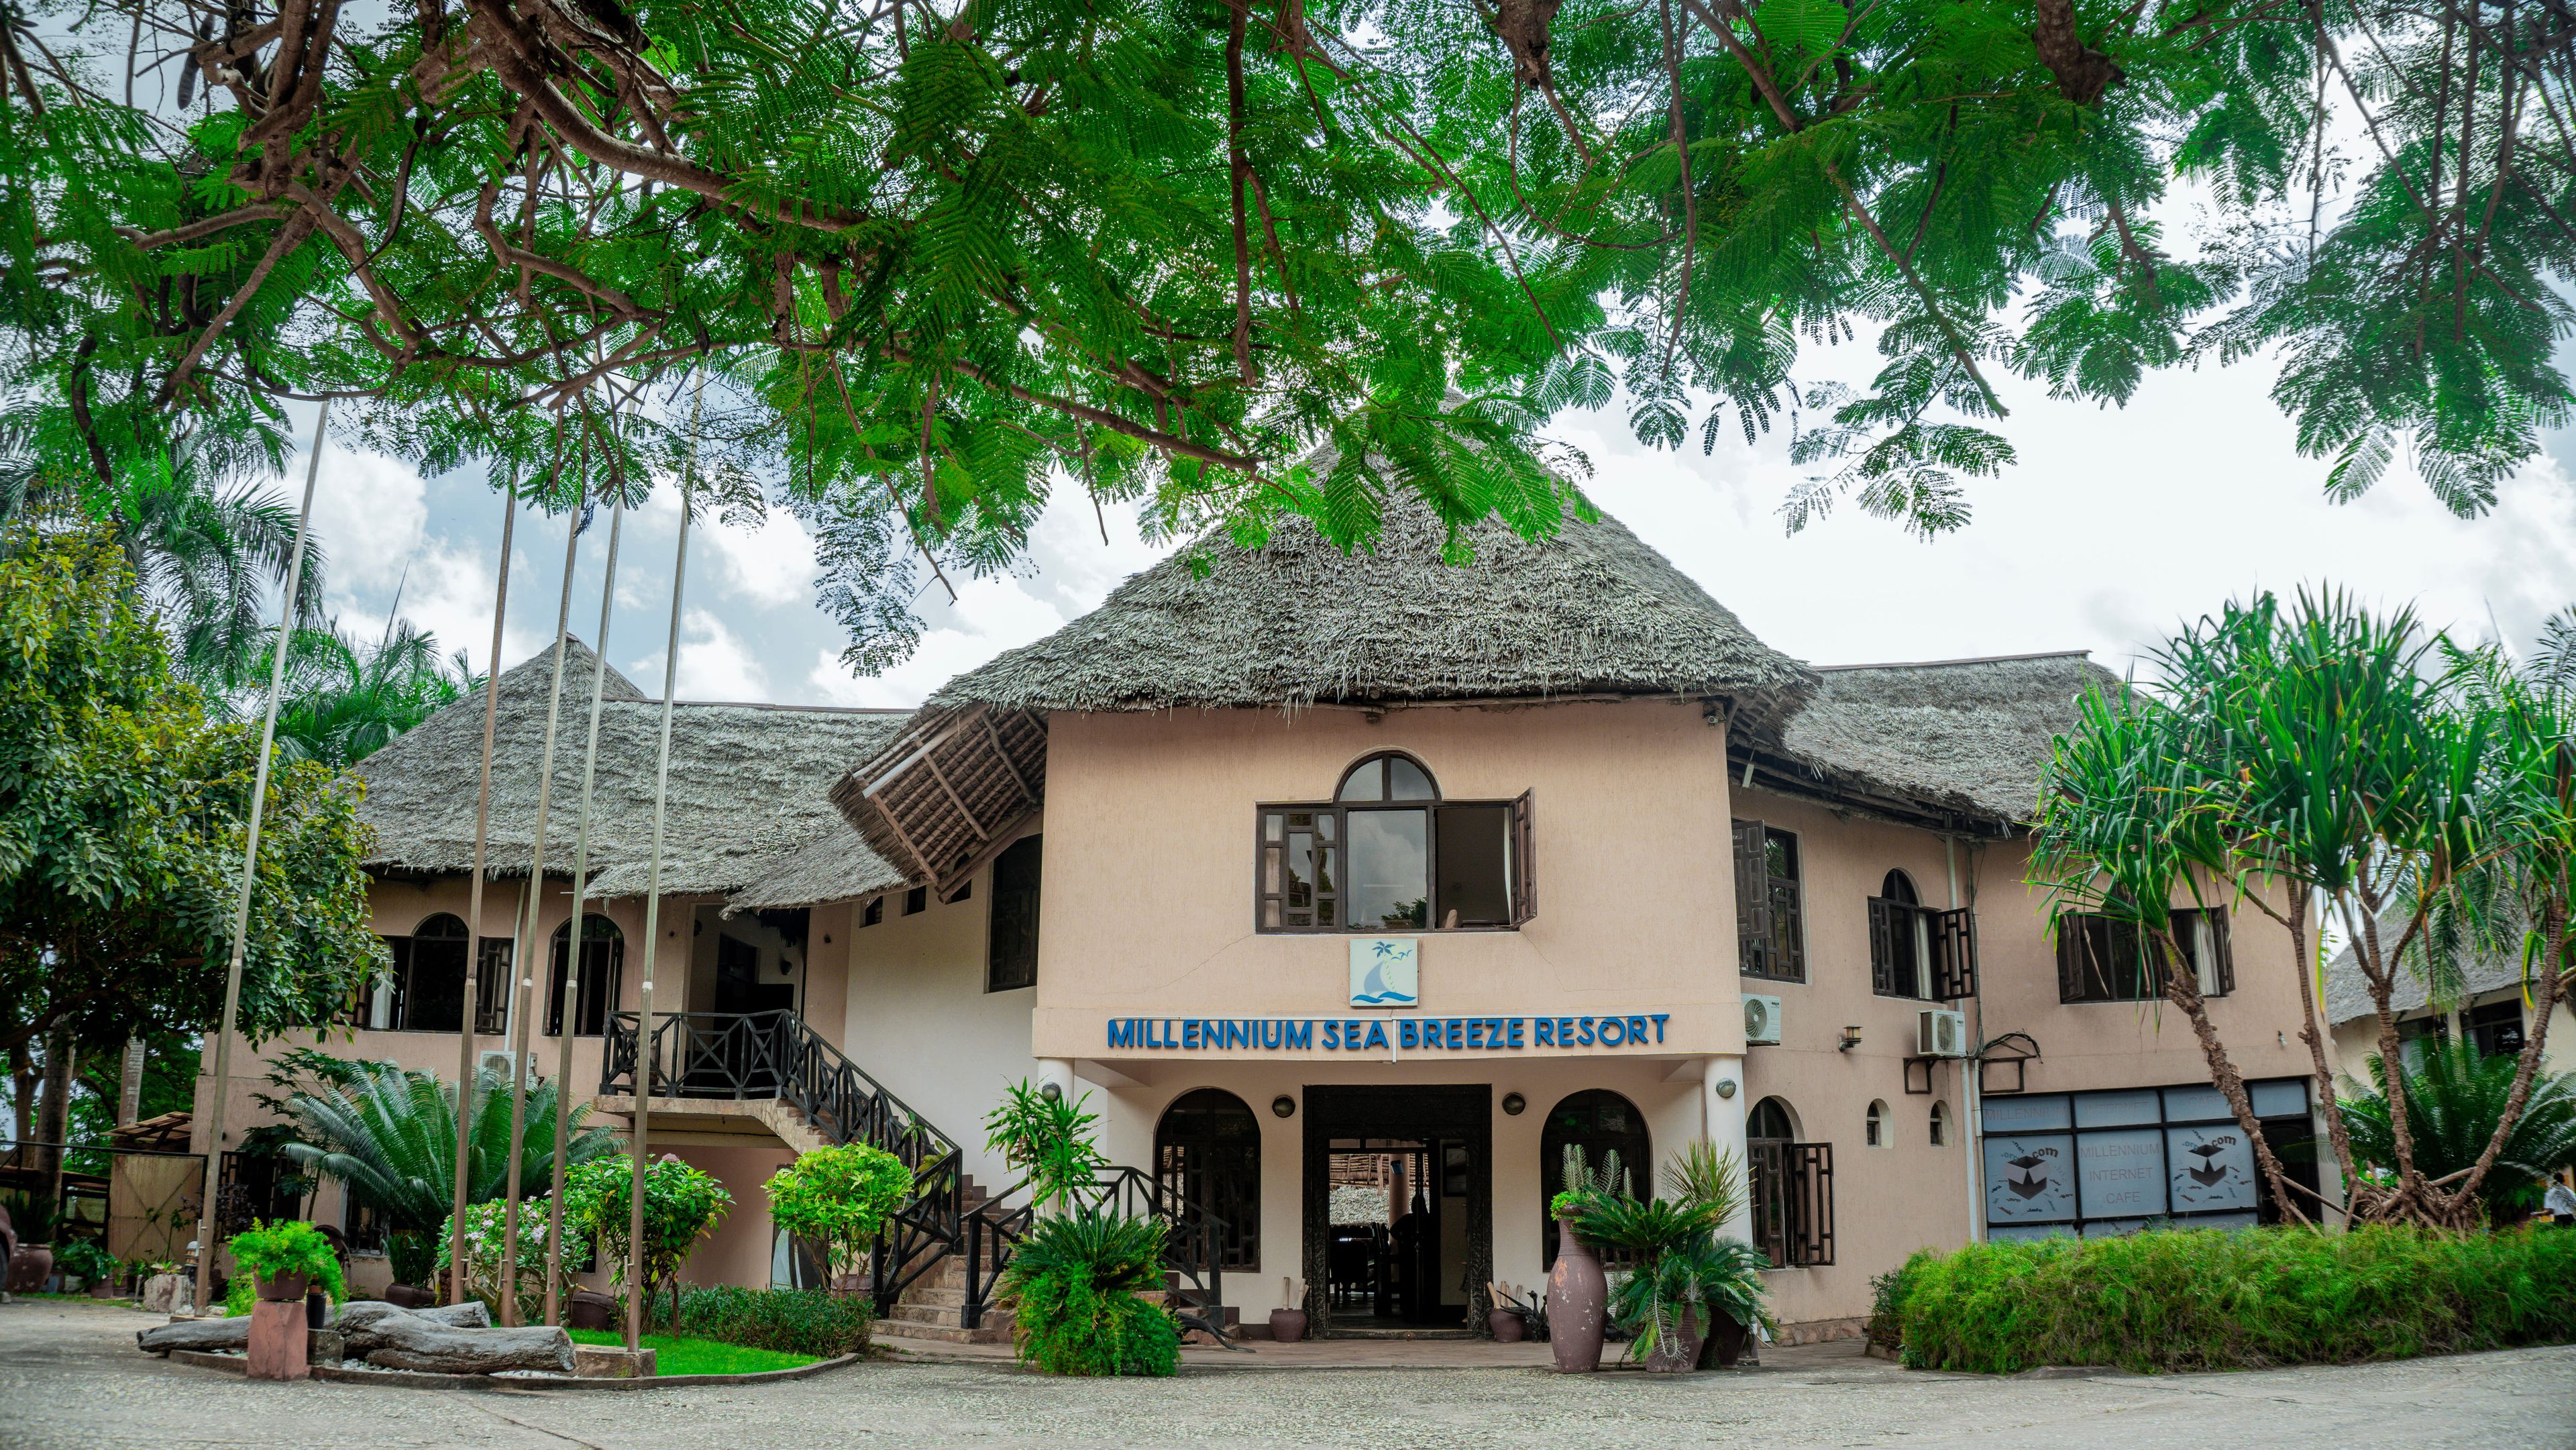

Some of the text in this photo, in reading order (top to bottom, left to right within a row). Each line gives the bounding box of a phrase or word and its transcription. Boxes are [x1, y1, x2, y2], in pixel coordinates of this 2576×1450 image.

[1108, 1014, 1670, 1049] MILLENNIUM SEA BREEZE RESORT
[1984, 1105, 2068, 1121] MILLENNIUM
[2188, 1096, 2223, 1108] CAFE
[2080, 1143, 2160, 1159] MILLENNIUM
[2089, 1167, 2153, 1182] INTERNET
[2106, 1191, 2141, 1204] CAFE
